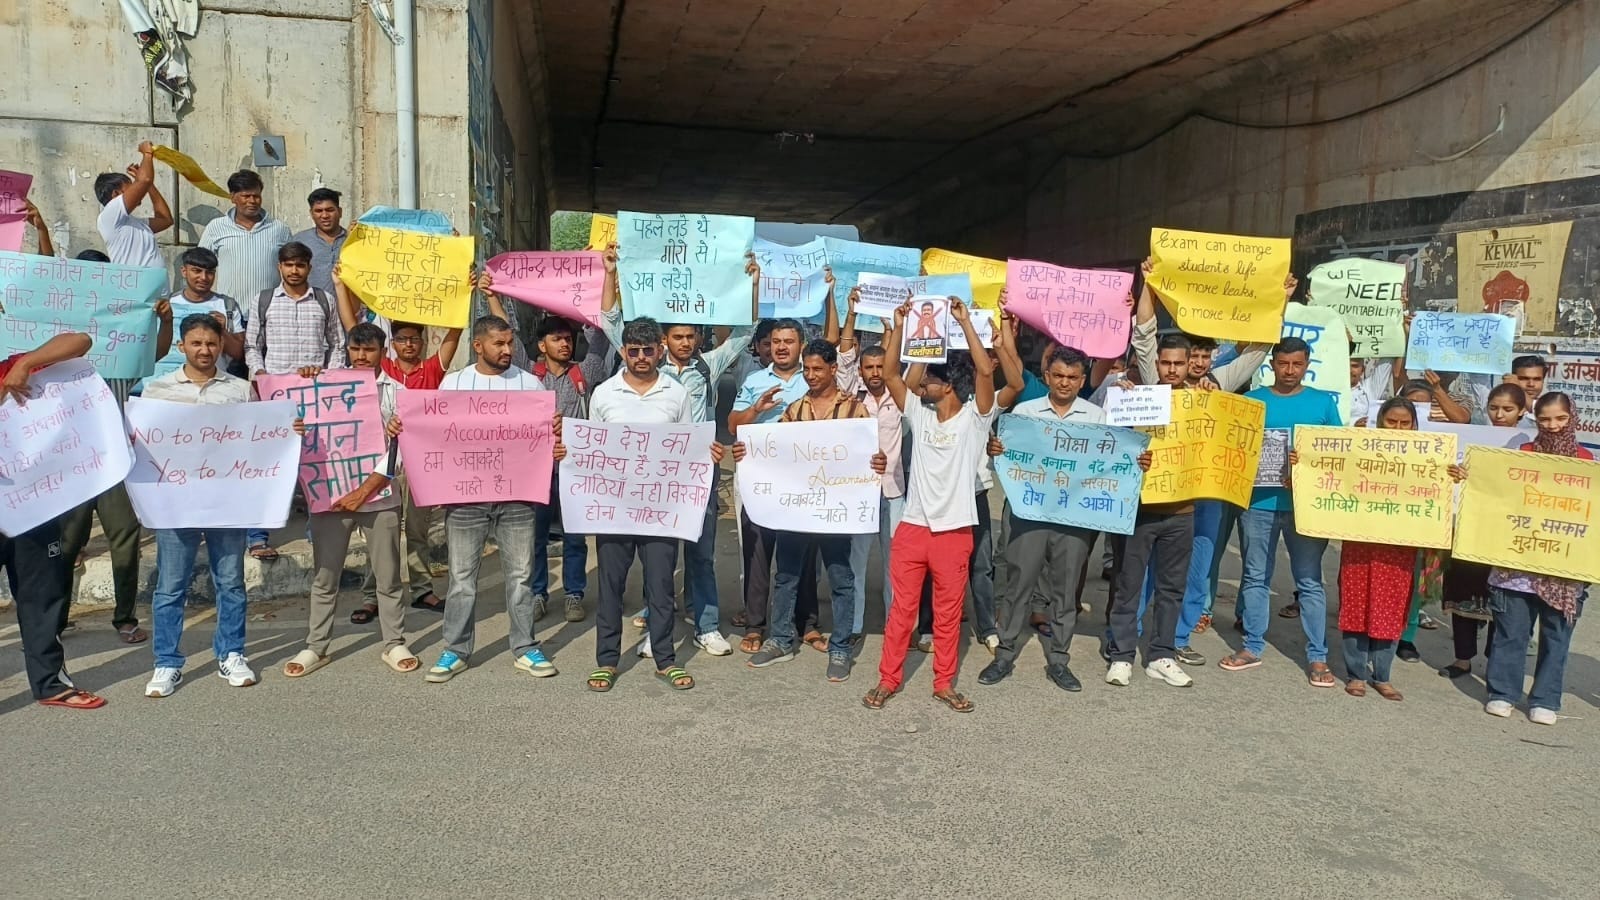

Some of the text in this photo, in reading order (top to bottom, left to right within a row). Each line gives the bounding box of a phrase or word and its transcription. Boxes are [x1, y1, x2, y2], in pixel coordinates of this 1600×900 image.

[1156, 230, 1272, 261] Exam can change
[1485, 242, 1536, 261] KEWAL
[1328, 269, 1362, 280] WE
[1160, 277, 1176, 292] No
[1188, 282, 1218, 295] more
[1192, 306, 1224, 321] more
[424, 395, 508, 415] We Need
[171, 428, 192, 444] to
[200, 425, 244, 444] Paper
[748, 433, 848, 462] WE NEED
[1312, 437, 1352, 452] सरकार
[1414, 439, 1430, 454] पर
[424, 452, 444, 472] हम
[1310, 456, 1346, 471] जनता
[150, 458, 186, 486] Yes
[194, 459, 216, 480] to
[225, 460, 281, 480] Merit
[1314, 472, 1342, 490] और
[1508, 467, 1592, 489] छात्र एकता
[584, 500, 616, 520] होना
[1405, 505, 1422, 518] पर
[1541, 518, 1589, 538] सरकार
